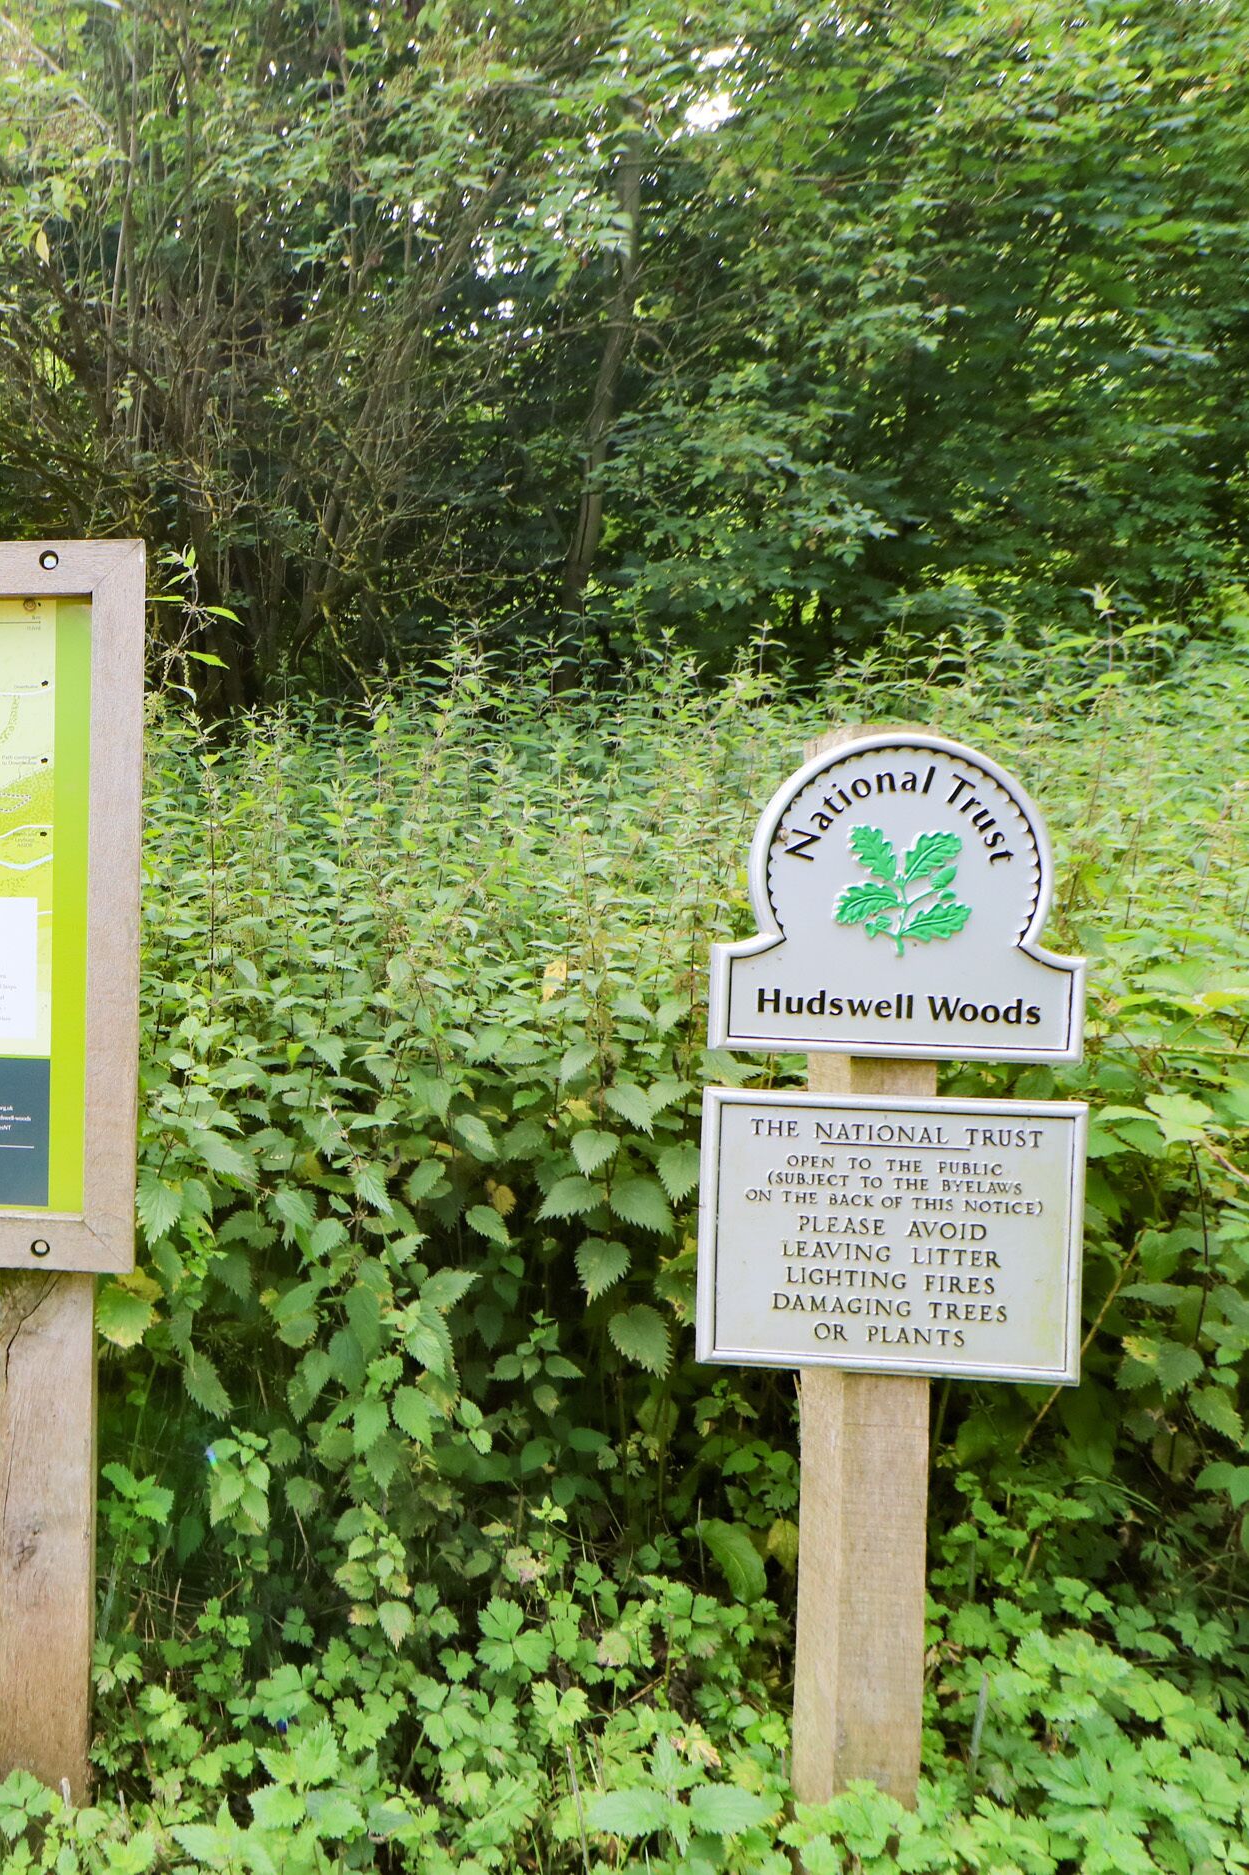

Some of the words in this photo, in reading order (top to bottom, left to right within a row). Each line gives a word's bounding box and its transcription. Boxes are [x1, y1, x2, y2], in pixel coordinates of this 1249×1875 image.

[784, 766, 936, 861] National
[944, 773, 1014, 866] Trust
[757, 988, 913, 1019] Hudswell
[927, 995, 1041, 1025] Woods
[751, 1118, 799, 1138] THE
[815, 1122, 949, 1145] NATIONAL
[965, 1128, 1044, 1148] TRUST
[787, 1154, 834, 1169] OPEN
[848, 1157, 871, 1170] TO
[886, 1158, 922, 1173] THE
[937, 1161, 1003, 1176] PUBLIC
[767, 1170, 849, 1188] (SUBJECT
[860, 1175, 883, 1189] TO
[894, 1177, 929, 1192] THE
[941, 1179, 1023, 1195] BYELAWS
[744, 1188, 771, 1202] ON
[782, 1190, 818, 1205] THE
[828, 1193, 873, 1208] BACK
[881, 1195, 903, 1210] OF
[911, 1196, 953, 1212] THIS
[962, 1199, 1044, 1215] NOTICE)
[797, 1215, 886, 1236] PLEASE
[906, 1221, 987, 1241] AVOID
[781, 1239, 891, 1263] LEAVING
[912, 1246, 1001, 1269] LITTER
[786, 1266, 907, 1290] LIGHTING
[924, 1273, 995, 1295] FIRES
[772, 1293, 912, 1318] DAMAGING
[929, 1301, 1008, 1323] TREES
[814, 1322, 847, 1342] OR
[866, 1326, 965, 1347] PLANTS
